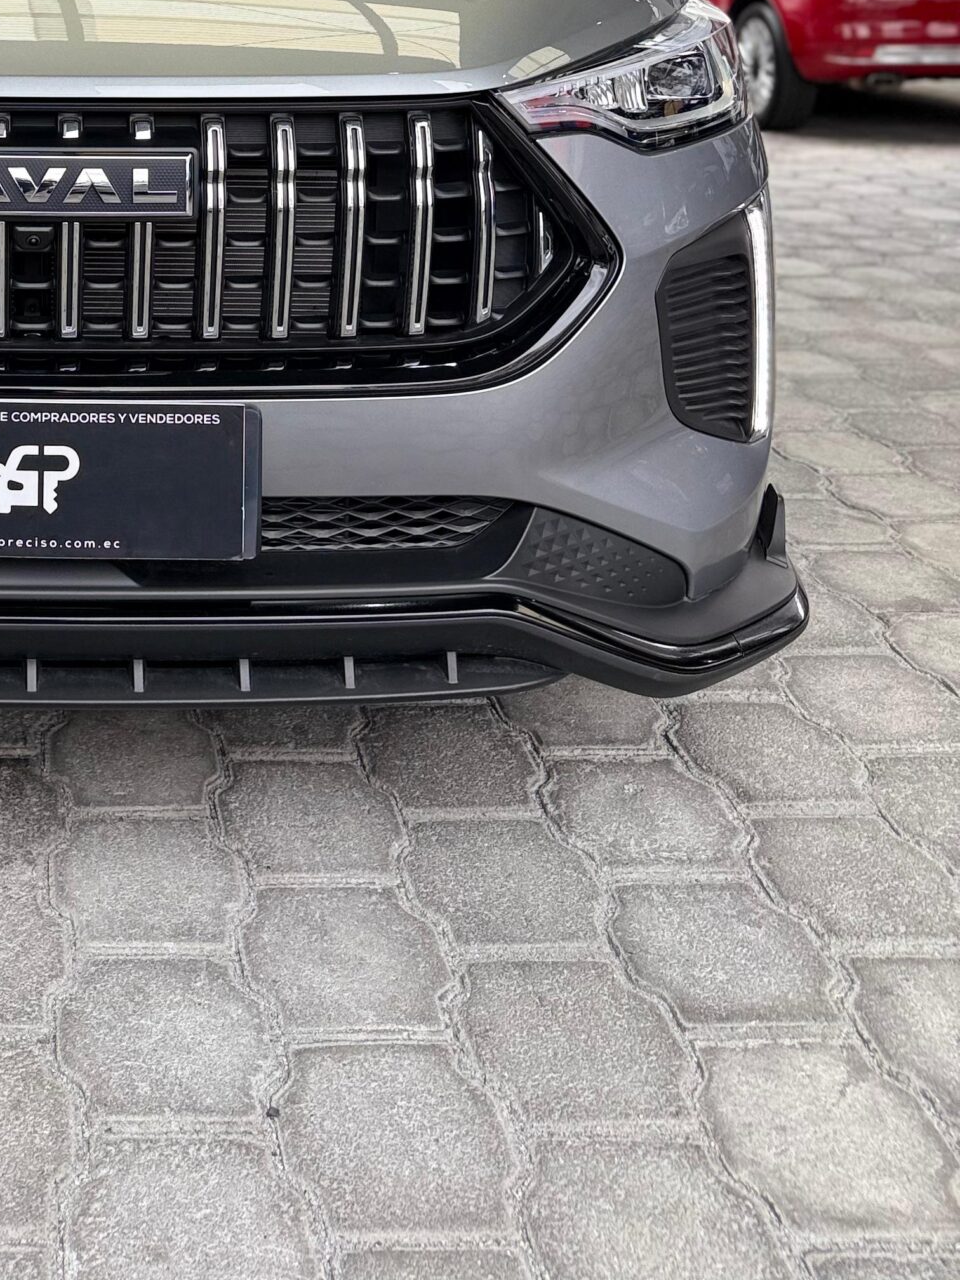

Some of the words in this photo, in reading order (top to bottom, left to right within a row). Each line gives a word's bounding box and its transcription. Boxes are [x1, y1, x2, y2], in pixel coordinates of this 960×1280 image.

[11, 411, 116, 424] COMPRADORES
[118, 413, 128, 423] Y
[129, 413, 221, 425] VENDEDORES
